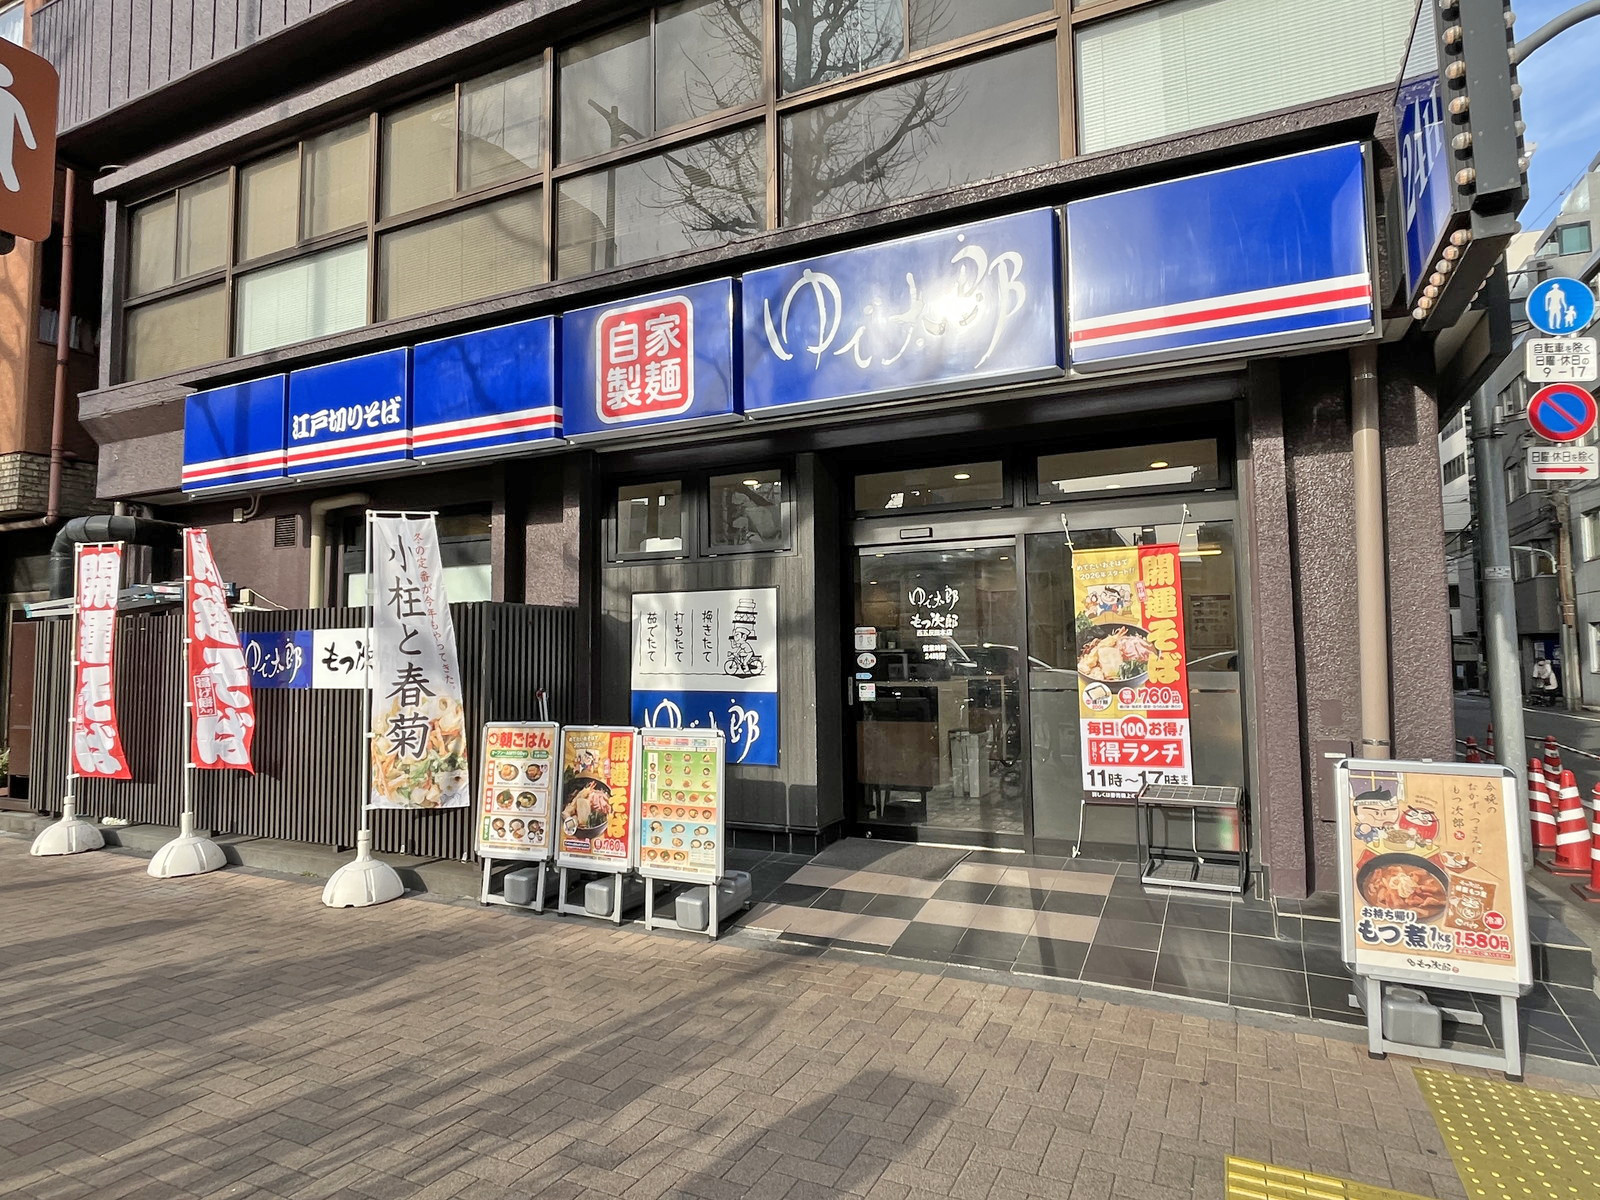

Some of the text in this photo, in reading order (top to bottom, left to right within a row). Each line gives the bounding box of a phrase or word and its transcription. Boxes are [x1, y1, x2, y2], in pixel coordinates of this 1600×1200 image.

[1402, 81, 1443, 232] 24H
[609, 312, 682, 364] 自家
[1534, 342, 1590, 354] 自転車を除く
[606, 362, 682, 410] 製麺
[292, 396, 402, 440] 江戸切りそば
[908, 585, 959, 611] ゆで太郎
[909, 612, 959, 629] もつ次郎
[1142, 553, 1183, 684] 開運そば
[384, 534, 437, 758] 小柱と春菊
[673, 609, 685, 663] 打ちたて
[701, 609, 713, 663] 挽きたて
[924, 652, 946, 660] 24時間
[499, 732, 551, 748] 朝ごはん
[1087, 721, 1115, 736] 毎日
[1098, 741, 1180, 764] 得ランチ
[607, 736, 631, 838] 開運そば
[1483, 781, 1499, 815] 今晩の
[1451, 785, 1465, 829] もつ次郎
[1361, 907, 1416, 922] お持ち帰り
[1357, 919, 1428, 948] もつ煮
[1429, 926, 1452, 943] 1kg
[1431, 942, 1451, 951] パック
